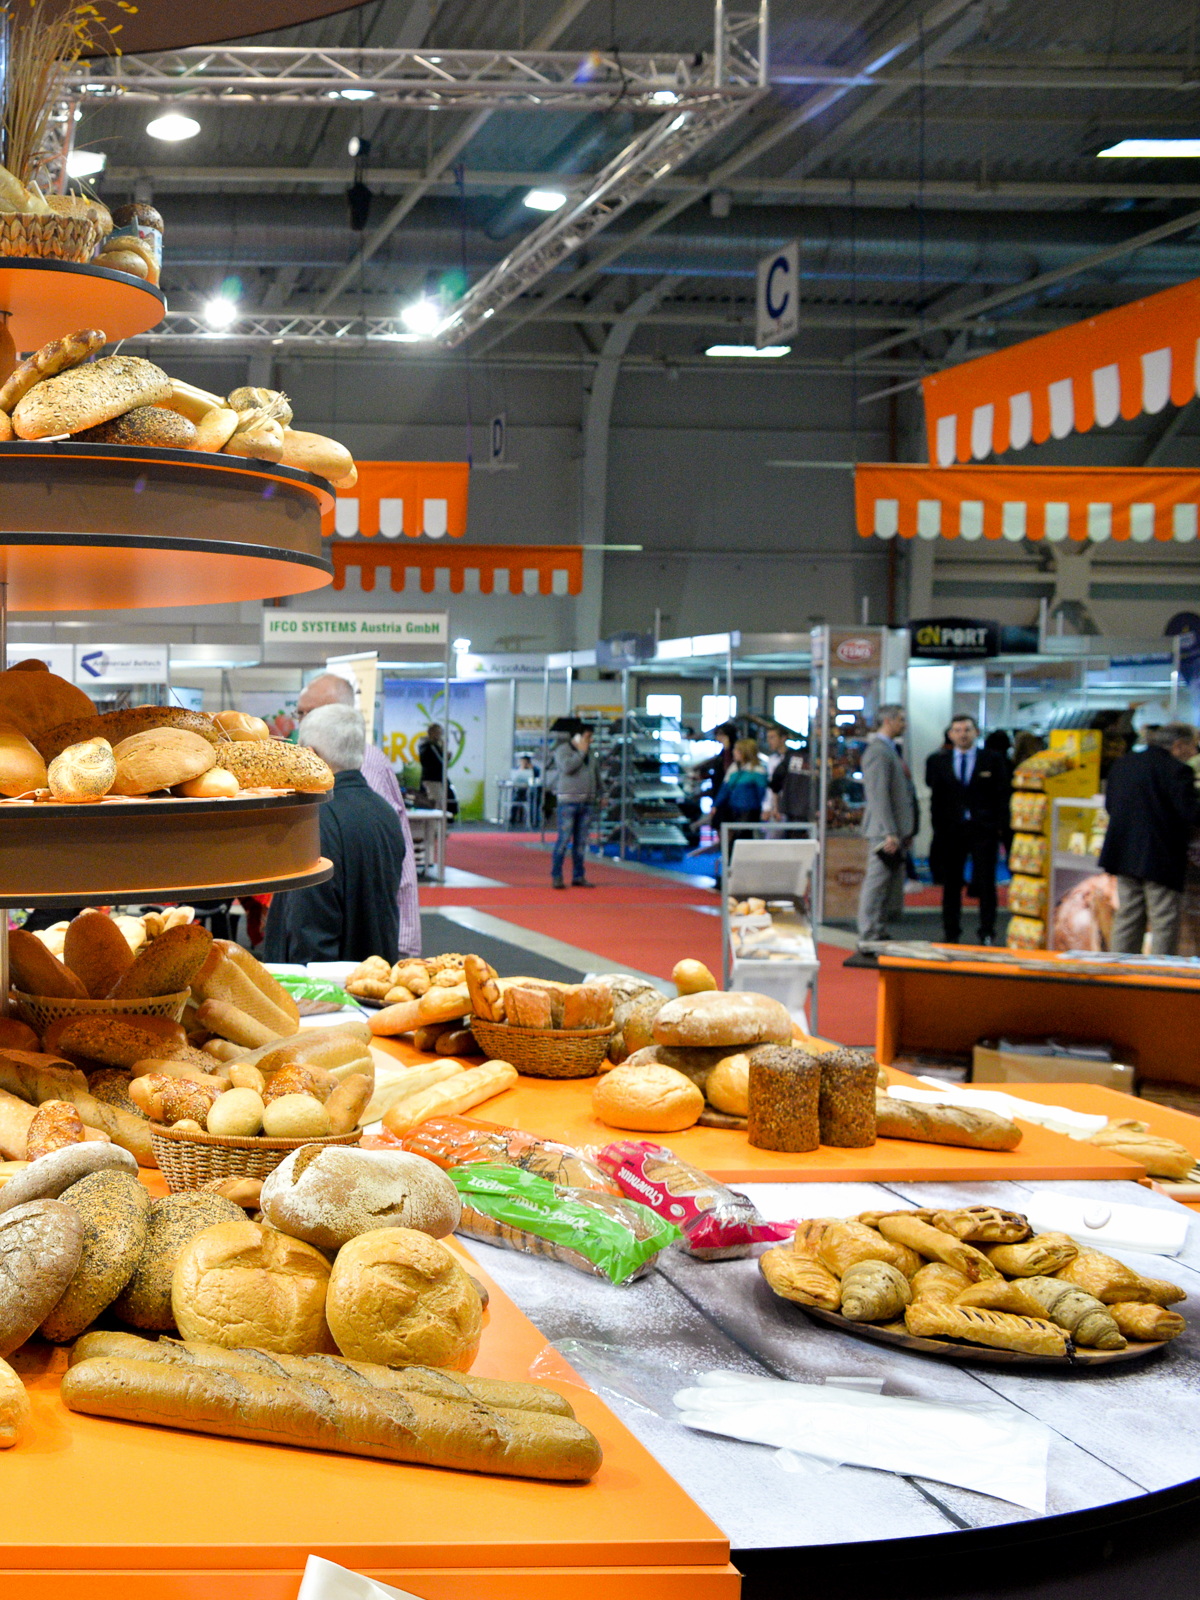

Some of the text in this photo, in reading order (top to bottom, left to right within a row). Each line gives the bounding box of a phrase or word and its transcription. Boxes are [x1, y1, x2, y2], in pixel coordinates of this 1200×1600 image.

[766, 256, 789, 318] C
[270, 621, 440, 634] IFCO SYSTEMS Austria GmbH
[618, 1166, 664, 1207] Столетник
